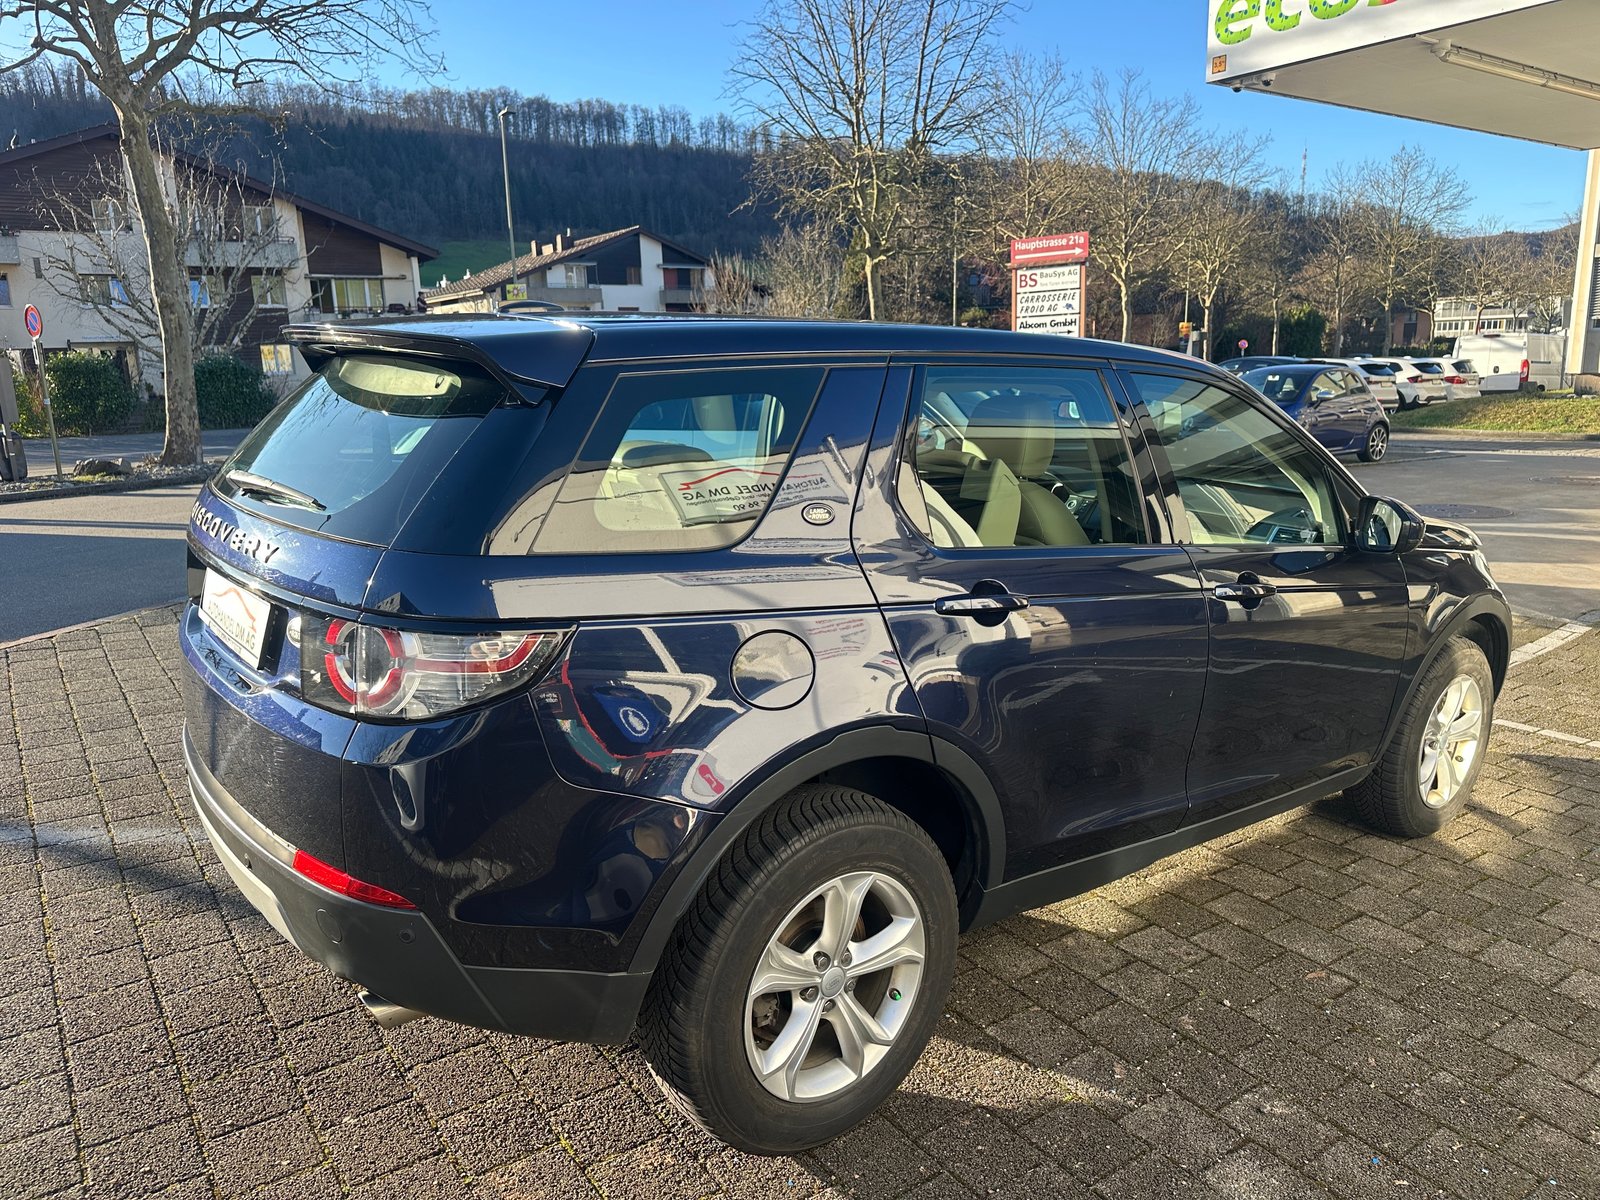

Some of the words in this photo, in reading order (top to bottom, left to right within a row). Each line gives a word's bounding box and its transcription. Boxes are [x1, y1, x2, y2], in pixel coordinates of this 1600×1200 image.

[1015, 238, 1067, 250] Hauptstrasse
[1069, 235, 1085, 244] 21a
[1040, 270, 1065, 279] BauSys
[1067, 268, 1078, 276] AG
[1019, 273, 1038, 288] BS
[1020, 292, 1077, 304] CARROSSERIE
[1047, 303, 1059, 312] AG
[1019, 320, 1047, 329] Abcom
[1049, 318, 1077, 328] GmbH
[191, 501, 279, 563] DISCOVERY
[245, 631, 256, 650] AG
